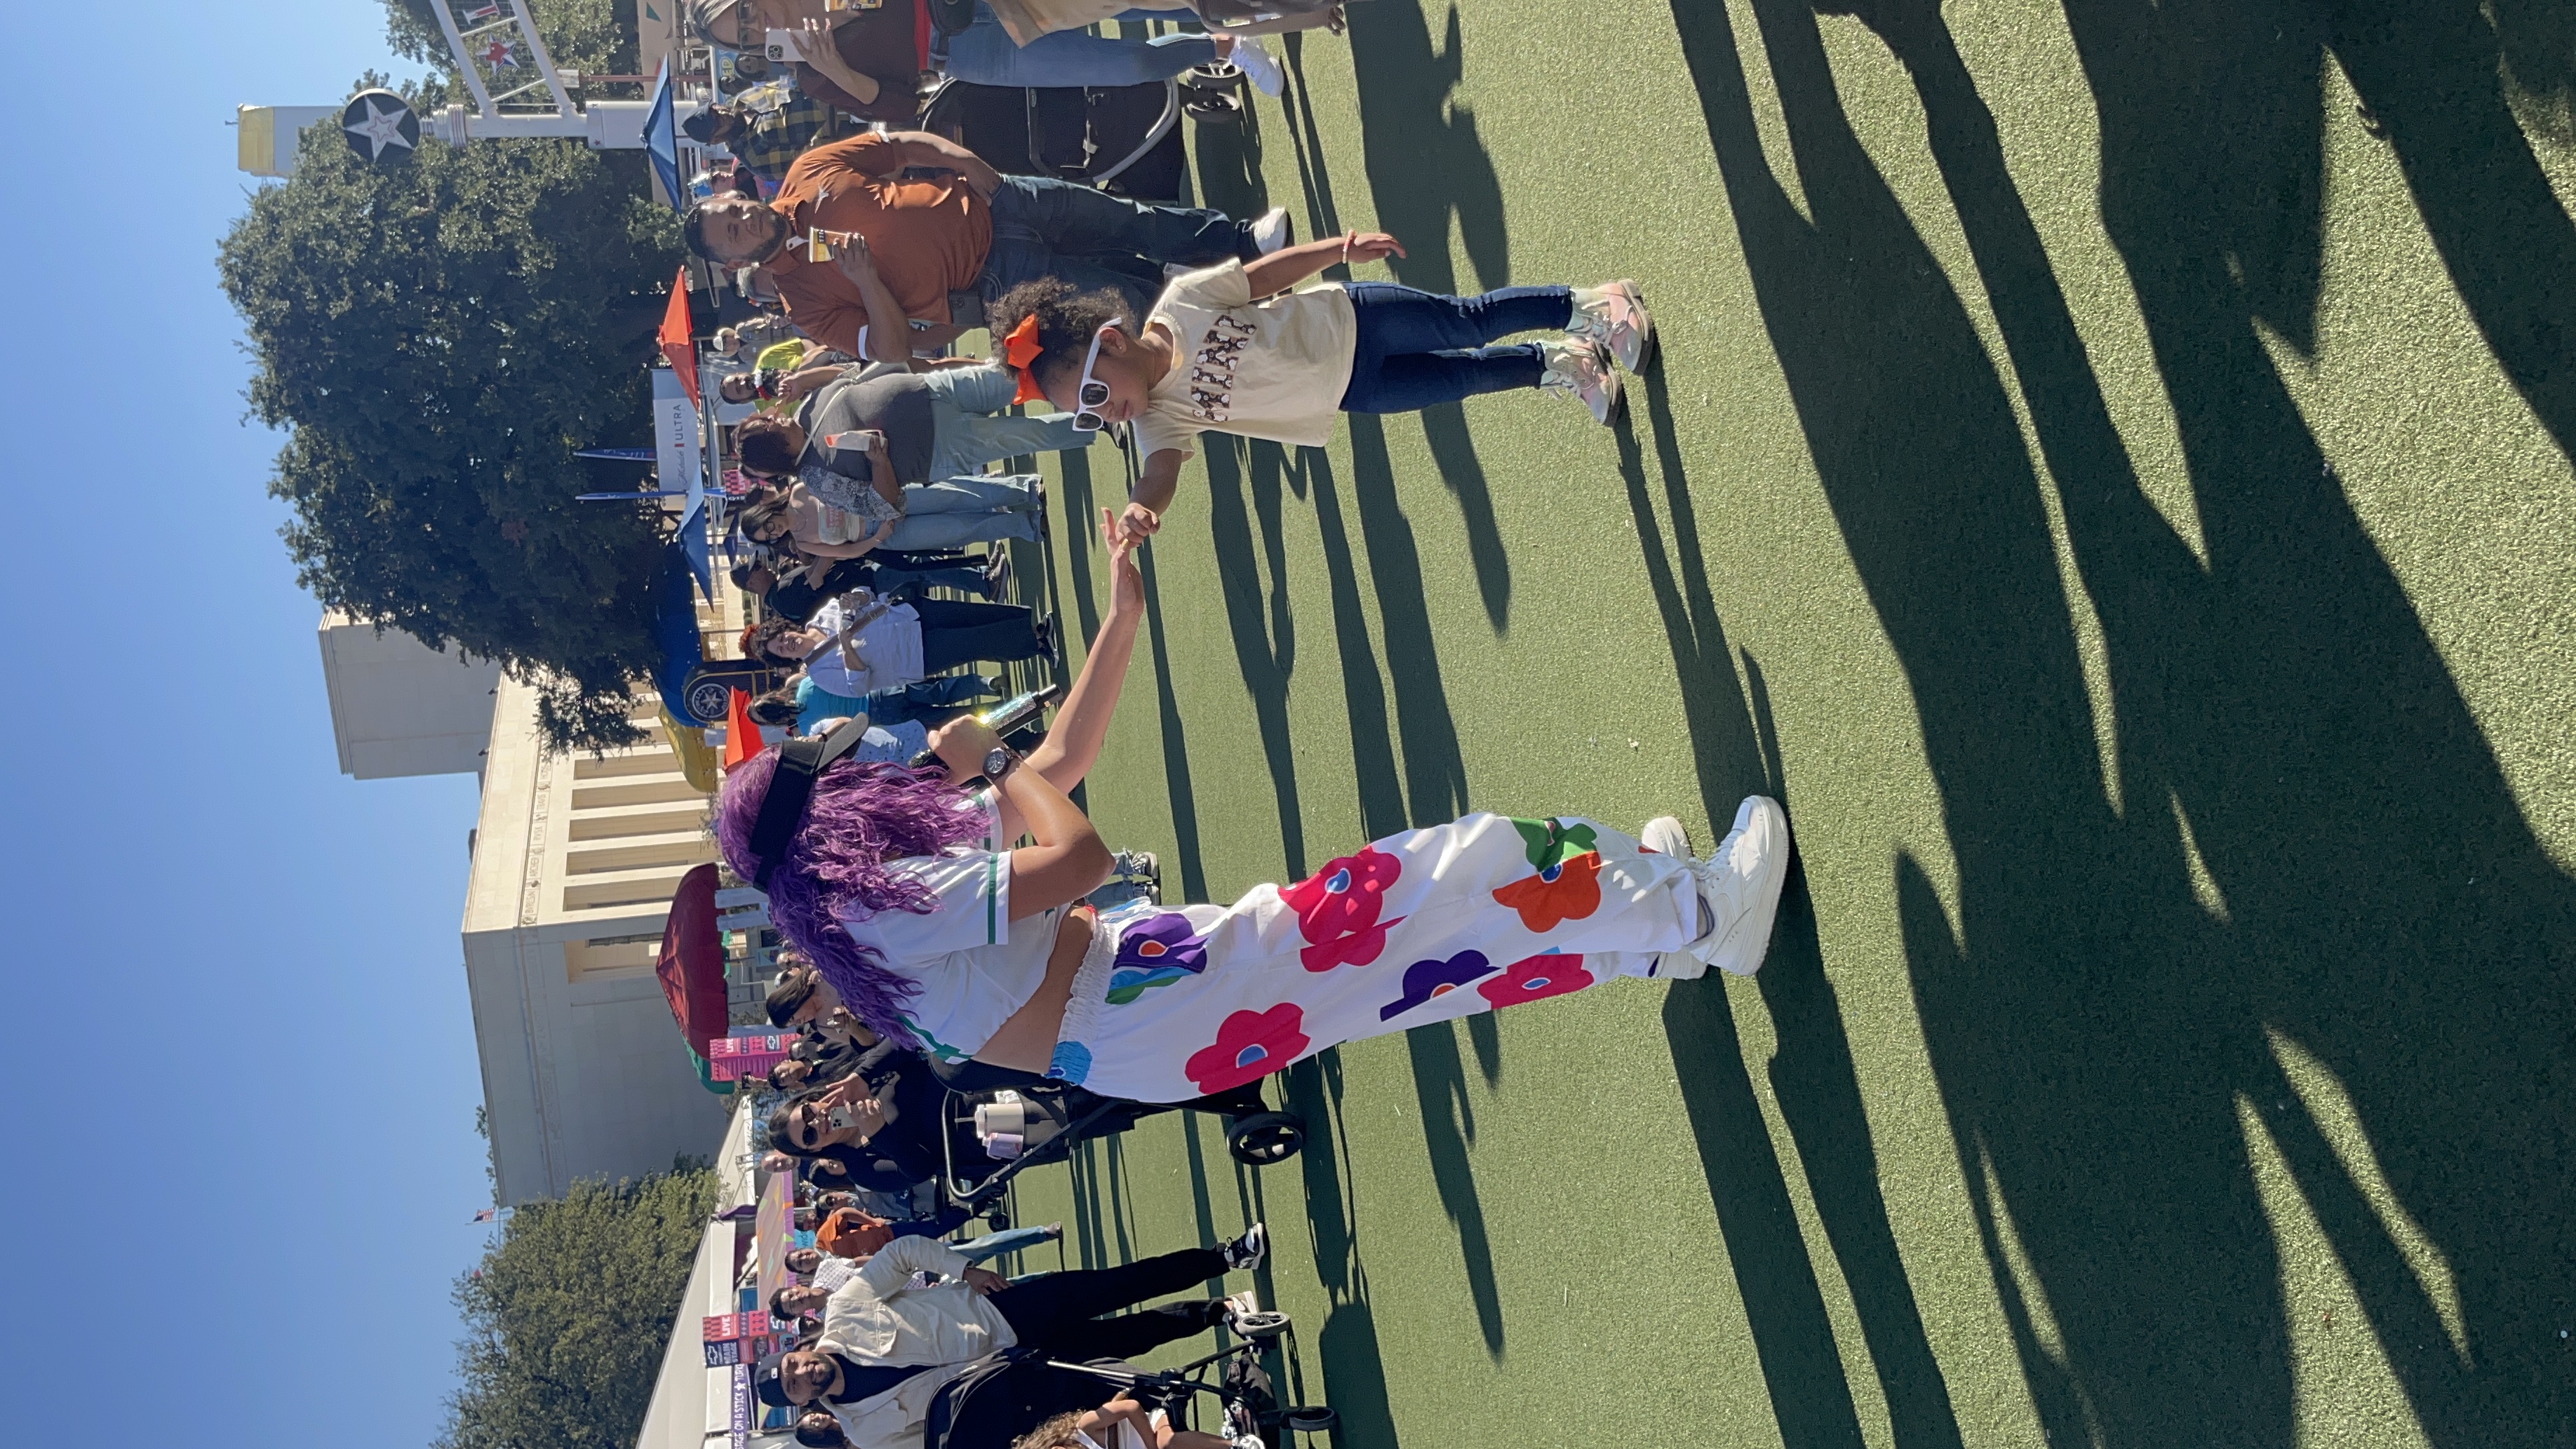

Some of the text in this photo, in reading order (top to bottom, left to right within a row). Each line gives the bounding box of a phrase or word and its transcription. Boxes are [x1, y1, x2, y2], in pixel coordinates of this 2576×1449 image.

[673, 404, 683, 440] ULTRA
[722, 1316, 730, 1336] LIVE
[723, 1342, 731, 1364] MAIN
[734, 1391, 744, 1413] STICK
[734, 1420, 744, 1430] ON
